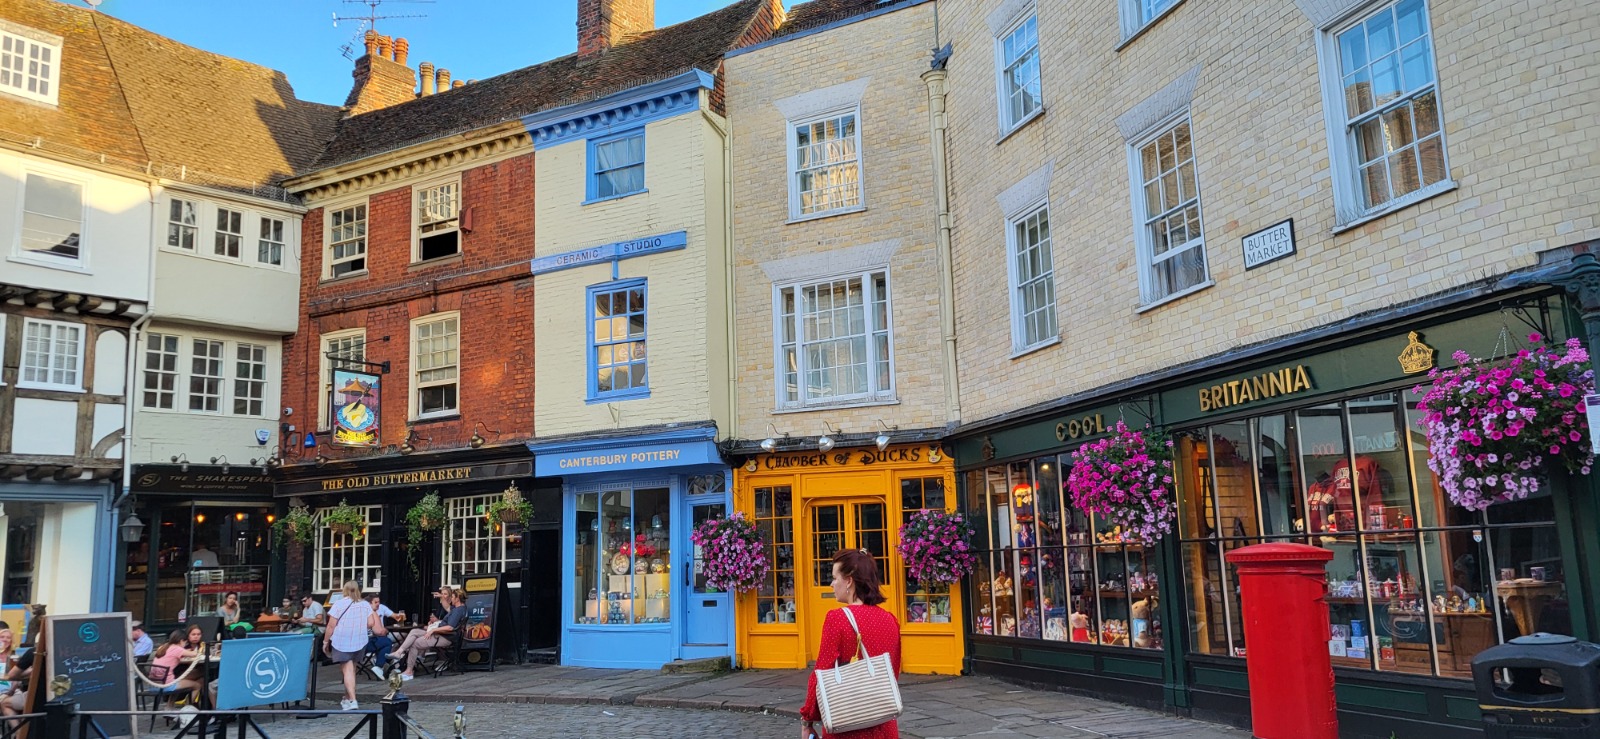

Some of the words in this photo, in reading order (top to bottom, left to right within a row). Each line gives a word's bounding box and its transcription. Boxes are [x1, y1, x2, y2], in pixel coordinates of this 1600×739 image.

[556, 249, 599, 265] CERAMIC
[623, 238, 662, 253] STUDIO
[1248, 228, 1287, 251] BUTTER
[1248, 238, 1290, 265] MARKET
[1199, 365, 1311, 412] BRITANNIA
[1055, 412, 1106, 442] COOL
[559, 454, 628, 469] CANTERBURY
[631, 449, 681, 463] POTTERY
[765, 453, 830, 470] CHAMBER
[858, 447, 921, 465] DUCKS
[321, 479, 344, 491] THE
[346, 476, 370, 488] OLD
[373, 467, 472, 486] BUTTERMARKET
[472, 607, 485, 615] PIE
